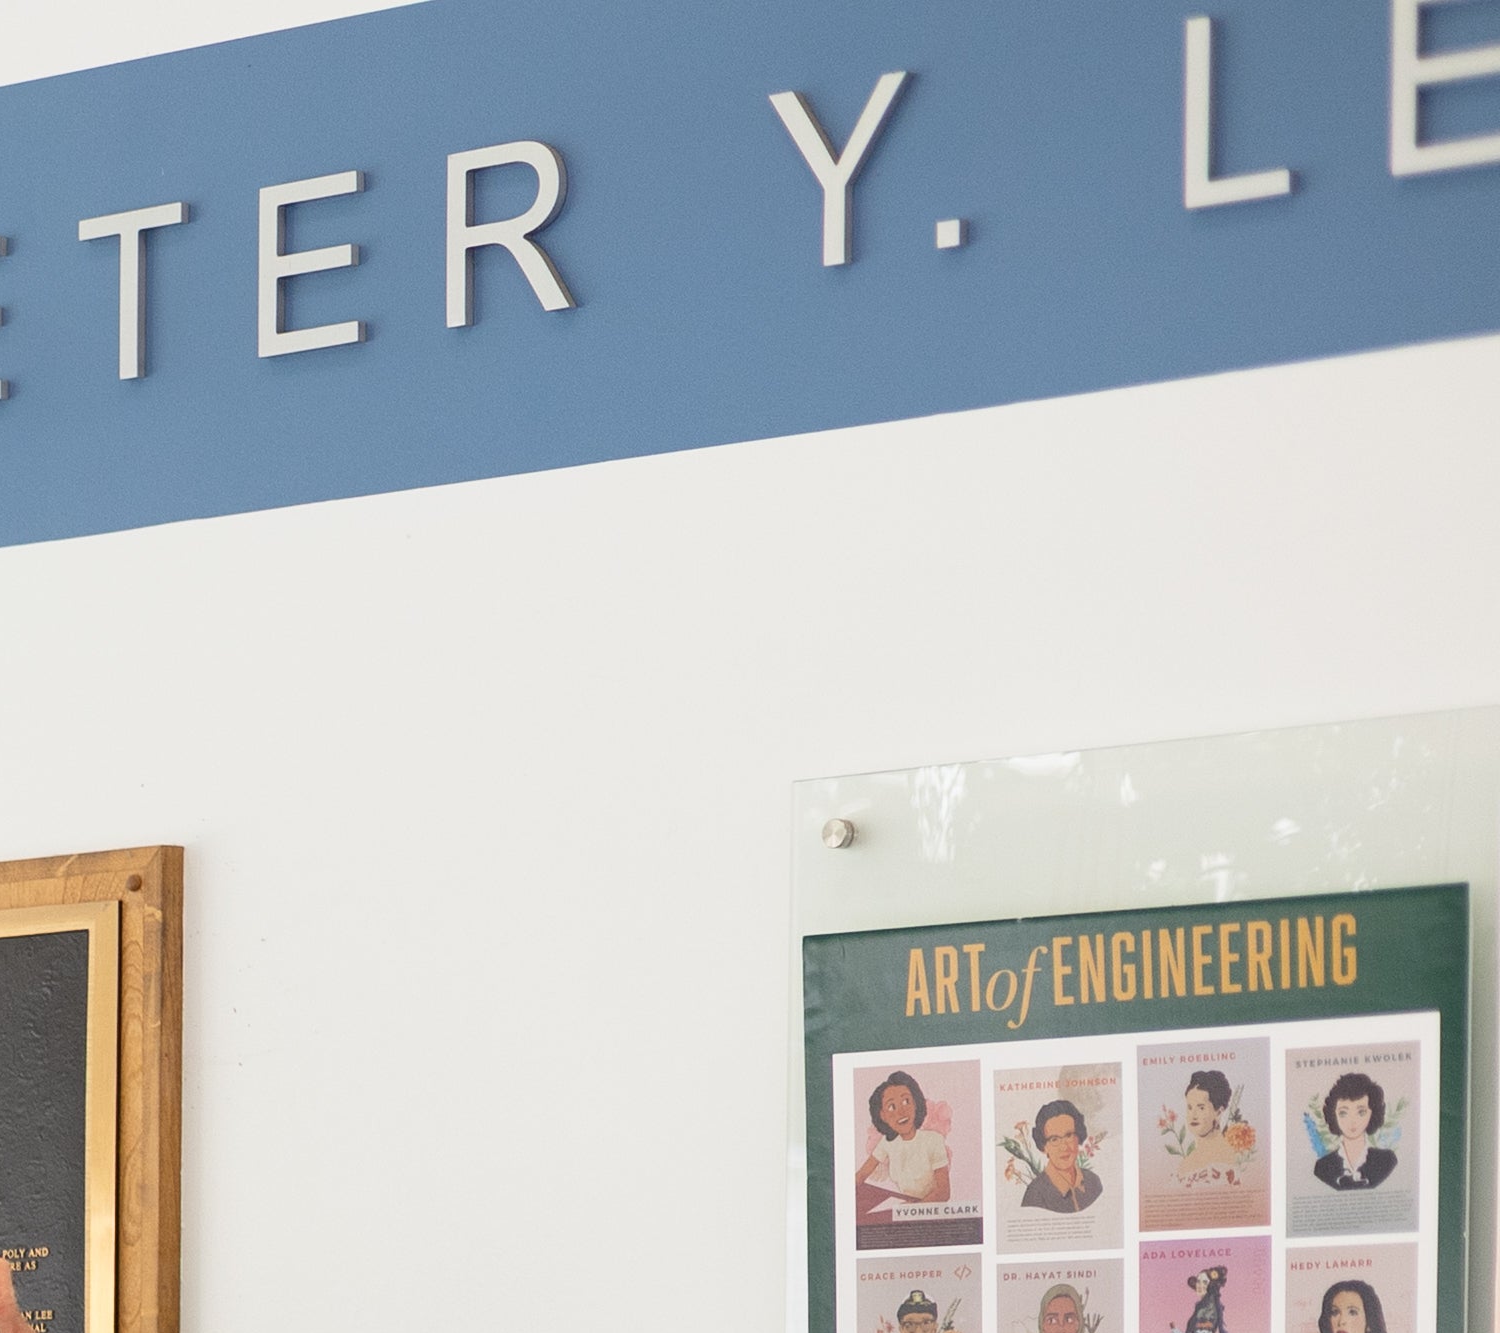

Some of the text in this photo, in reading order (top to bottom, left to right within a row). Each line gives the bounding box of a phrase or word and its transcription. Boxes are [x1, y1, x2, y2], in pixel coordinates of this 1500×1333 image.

[768, 69, 966, 267] Y.
[904, 913, 1358, 1030] ART of ENGINEERING
[1142, 1051, 1238, 1066] EMILY ROEBLING
[1295, 1052, 1413, 1069] STEPHANIE KWOLEK
[999, 1077, 1117, 1093] KATHERINE JOHNSON
[895, 1204, 980, 1217] YVONNE CLARK
[2, 1248, 25, 1259] POLY
[28, 1246, 49, 1257] AND
[1142, 1247, 1233, 1260] ADA LOVELACE
[24, 1260, 36, 1270] AS
[1290, 1258, 1374, 1271] HEDY LAMARR
[860, 1269, 943, 1282] GRACE HOPPER
[1003, 1269, 1098, 1282] DR. HAYAT SINDI
[35, 1309, 53, 1320] LEE
